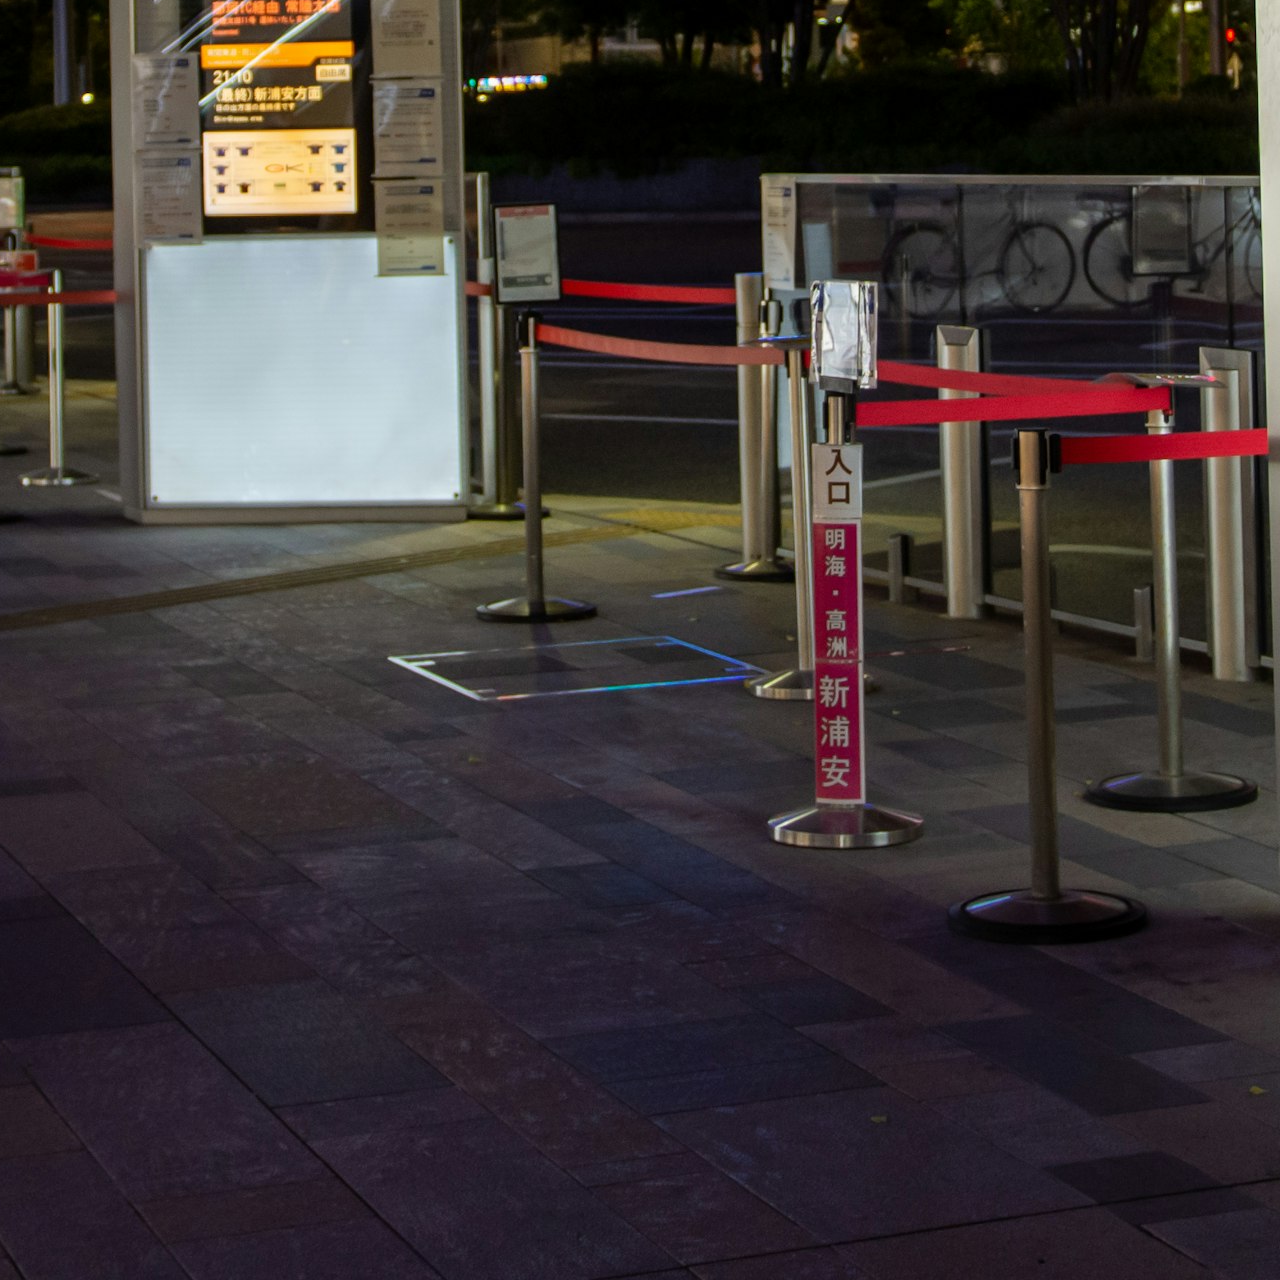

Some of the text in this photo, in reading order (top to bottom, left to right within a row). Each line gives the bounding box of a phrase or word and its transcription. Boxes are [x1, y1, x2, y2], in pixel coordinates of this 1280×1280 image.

[825, 448, 852, 506] 入口
[824, 528, 848, 659] 明海・高洲
[819, 674, 852, 789] 新浦安
